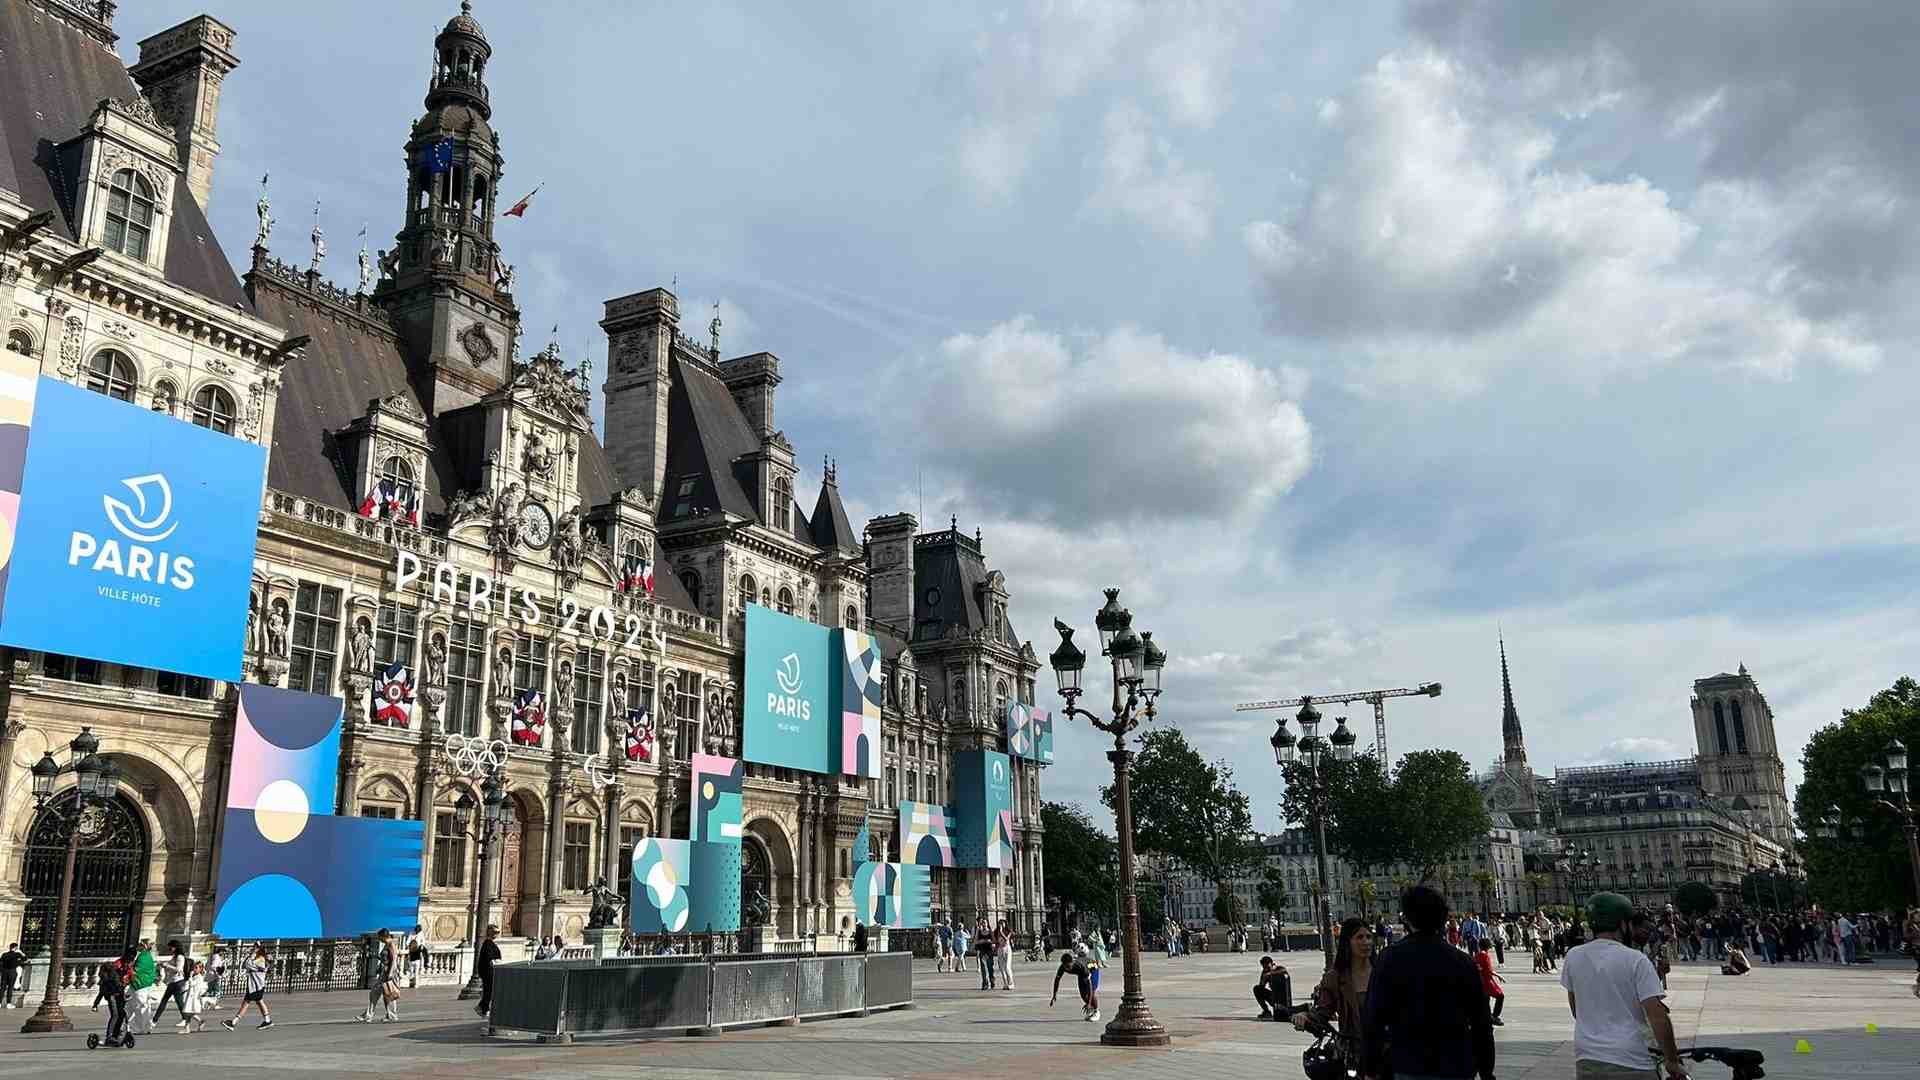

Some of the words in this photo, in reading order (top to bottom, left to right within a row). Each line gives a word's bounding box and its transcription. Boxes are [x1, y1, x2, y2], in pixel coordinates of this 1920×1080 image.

[68, 531, 195, 591] PARIS
[98, 585, 129, 601] VILLE
[131, 591, 161, 608] HÔTE
[395, 550, 542, 626] PARIS
[560, 596, 667, 657] 2024
[767, 692, 811, 721] PARIS
